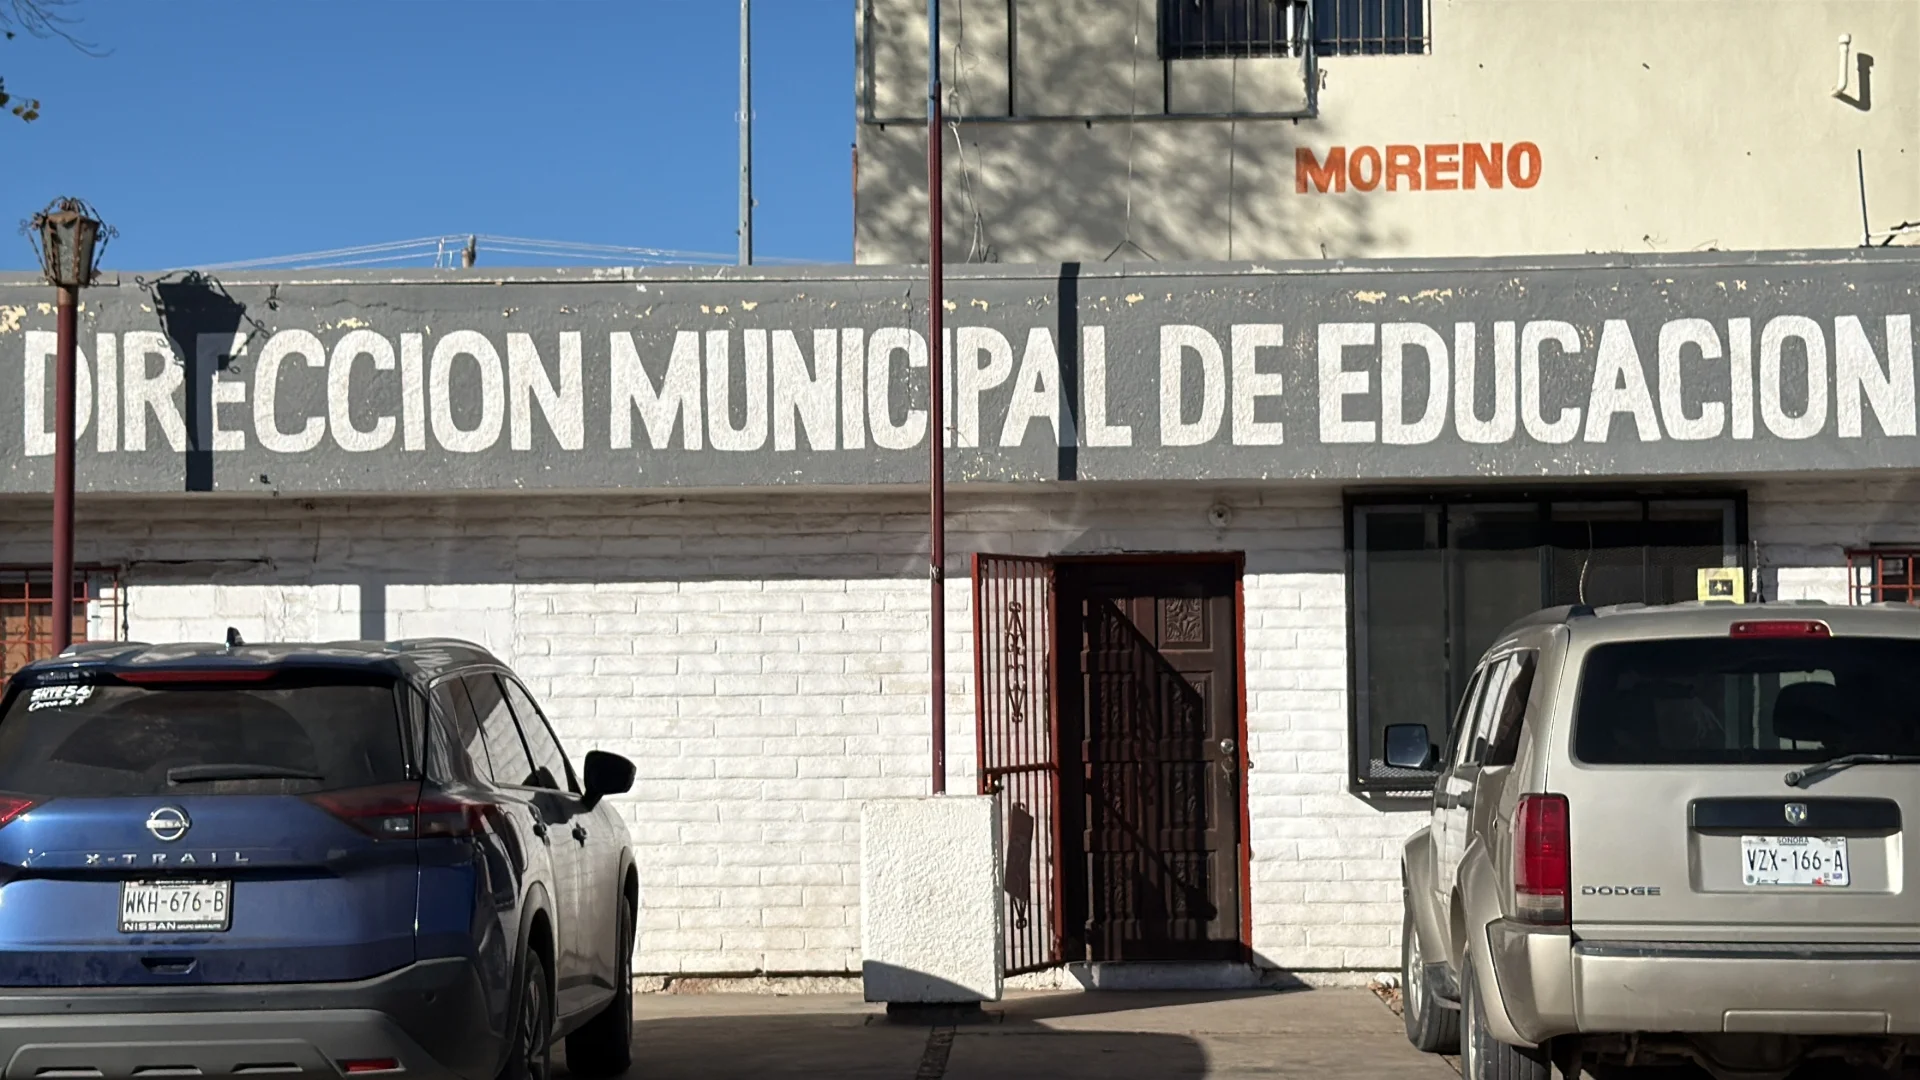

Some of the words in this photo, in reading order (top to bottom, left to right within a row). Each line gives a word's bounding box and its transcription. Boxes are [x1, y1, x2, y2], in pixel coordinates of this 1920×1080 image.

[1295, 141, 1542, 194] MORENO
[24, 329, 585, 457] DIRECCION
[1160, 324, 1283, 446] DE
[1318, 314, 1917, 445] EDUCACION
[86, 852, 249, 864] X-TRAIL
[1747, 849, 1843, 871] VZX-166-A
[1581, 886, 1661, 896] DODGE
[125, 891, 224, 914] WKH-676-B
[124, 922, 176, 931] NISSAN
